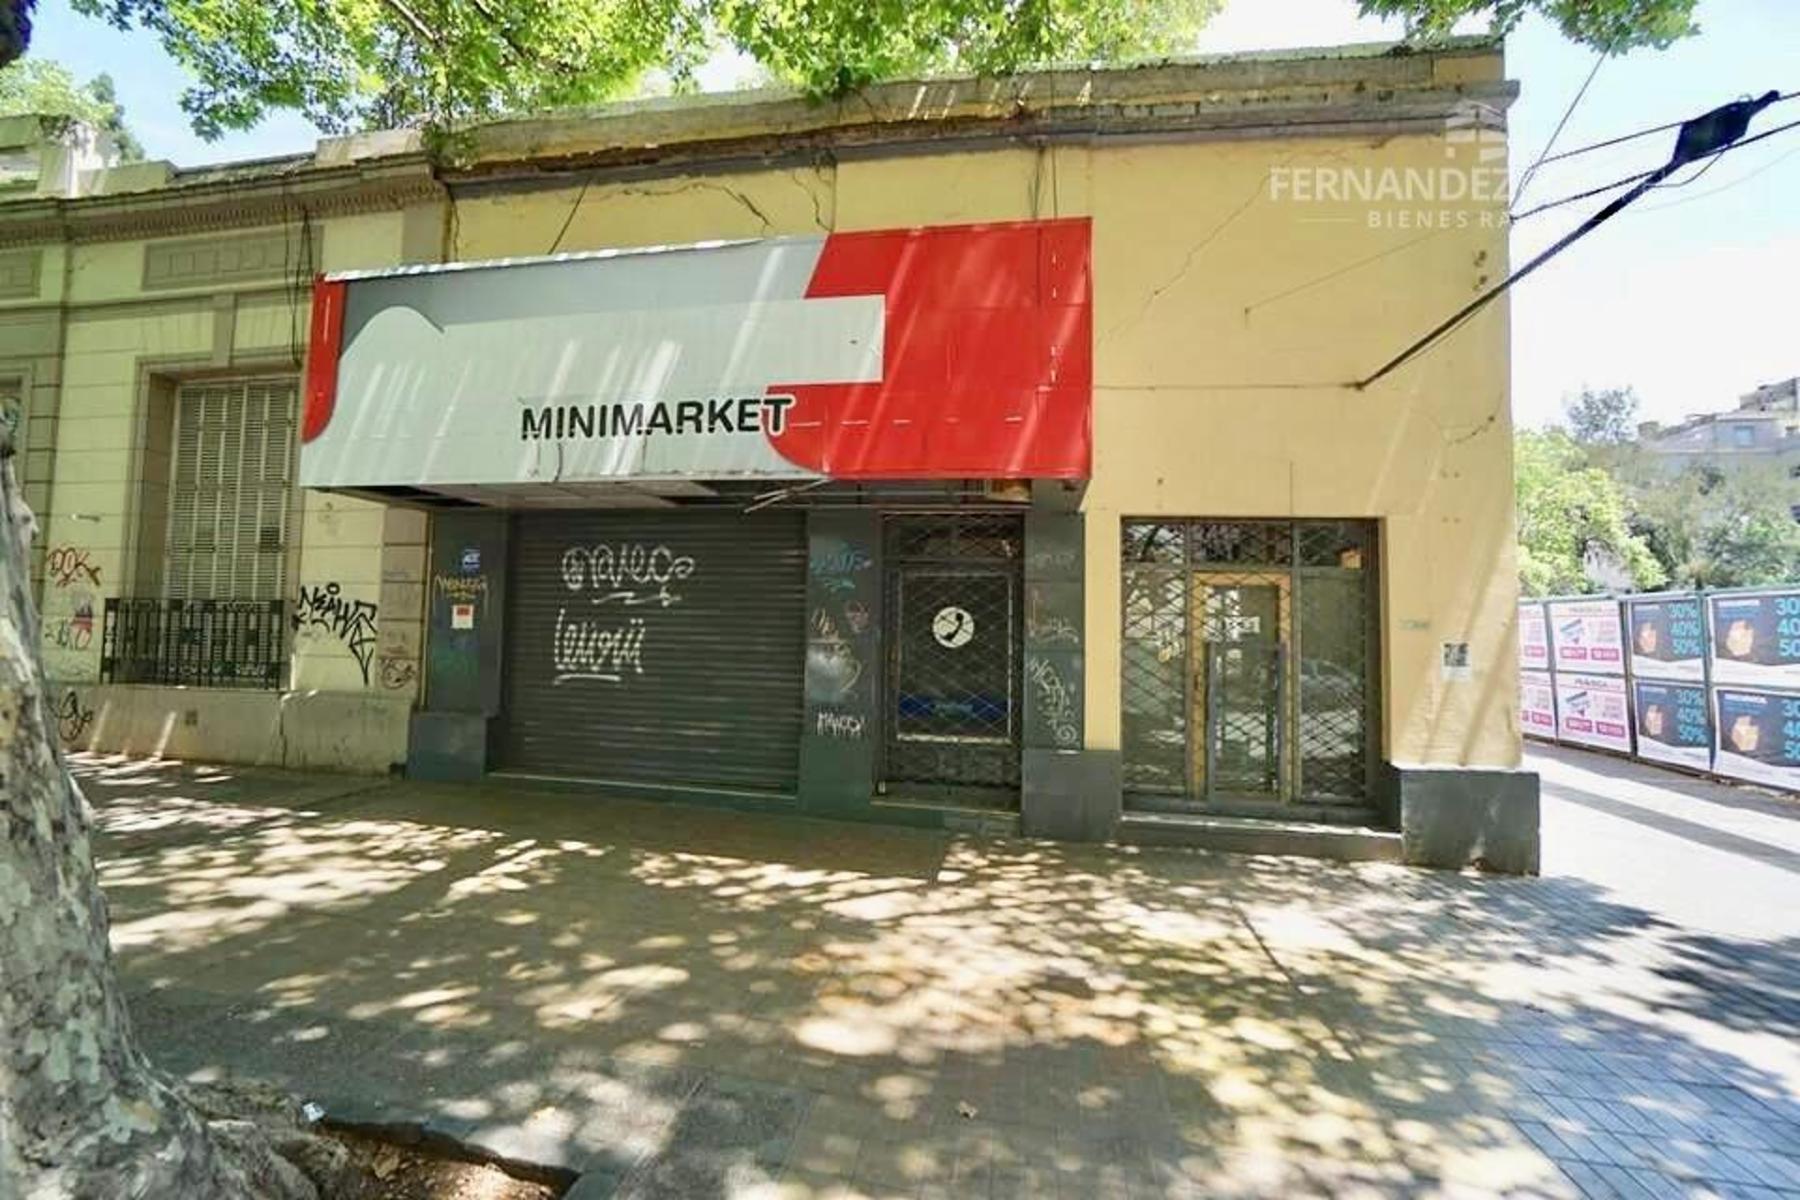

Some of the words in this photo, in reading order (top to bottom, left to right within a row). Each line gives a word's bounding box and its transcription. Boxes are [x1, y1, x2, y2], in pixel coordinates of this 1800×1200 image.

[520, 394, 796, 441] MINIMARKET
[1667, 602, 1698, 618] 30%
[1670, 620, 1700, 637] 40%
[1673, 638, 1703, 655] 50%
